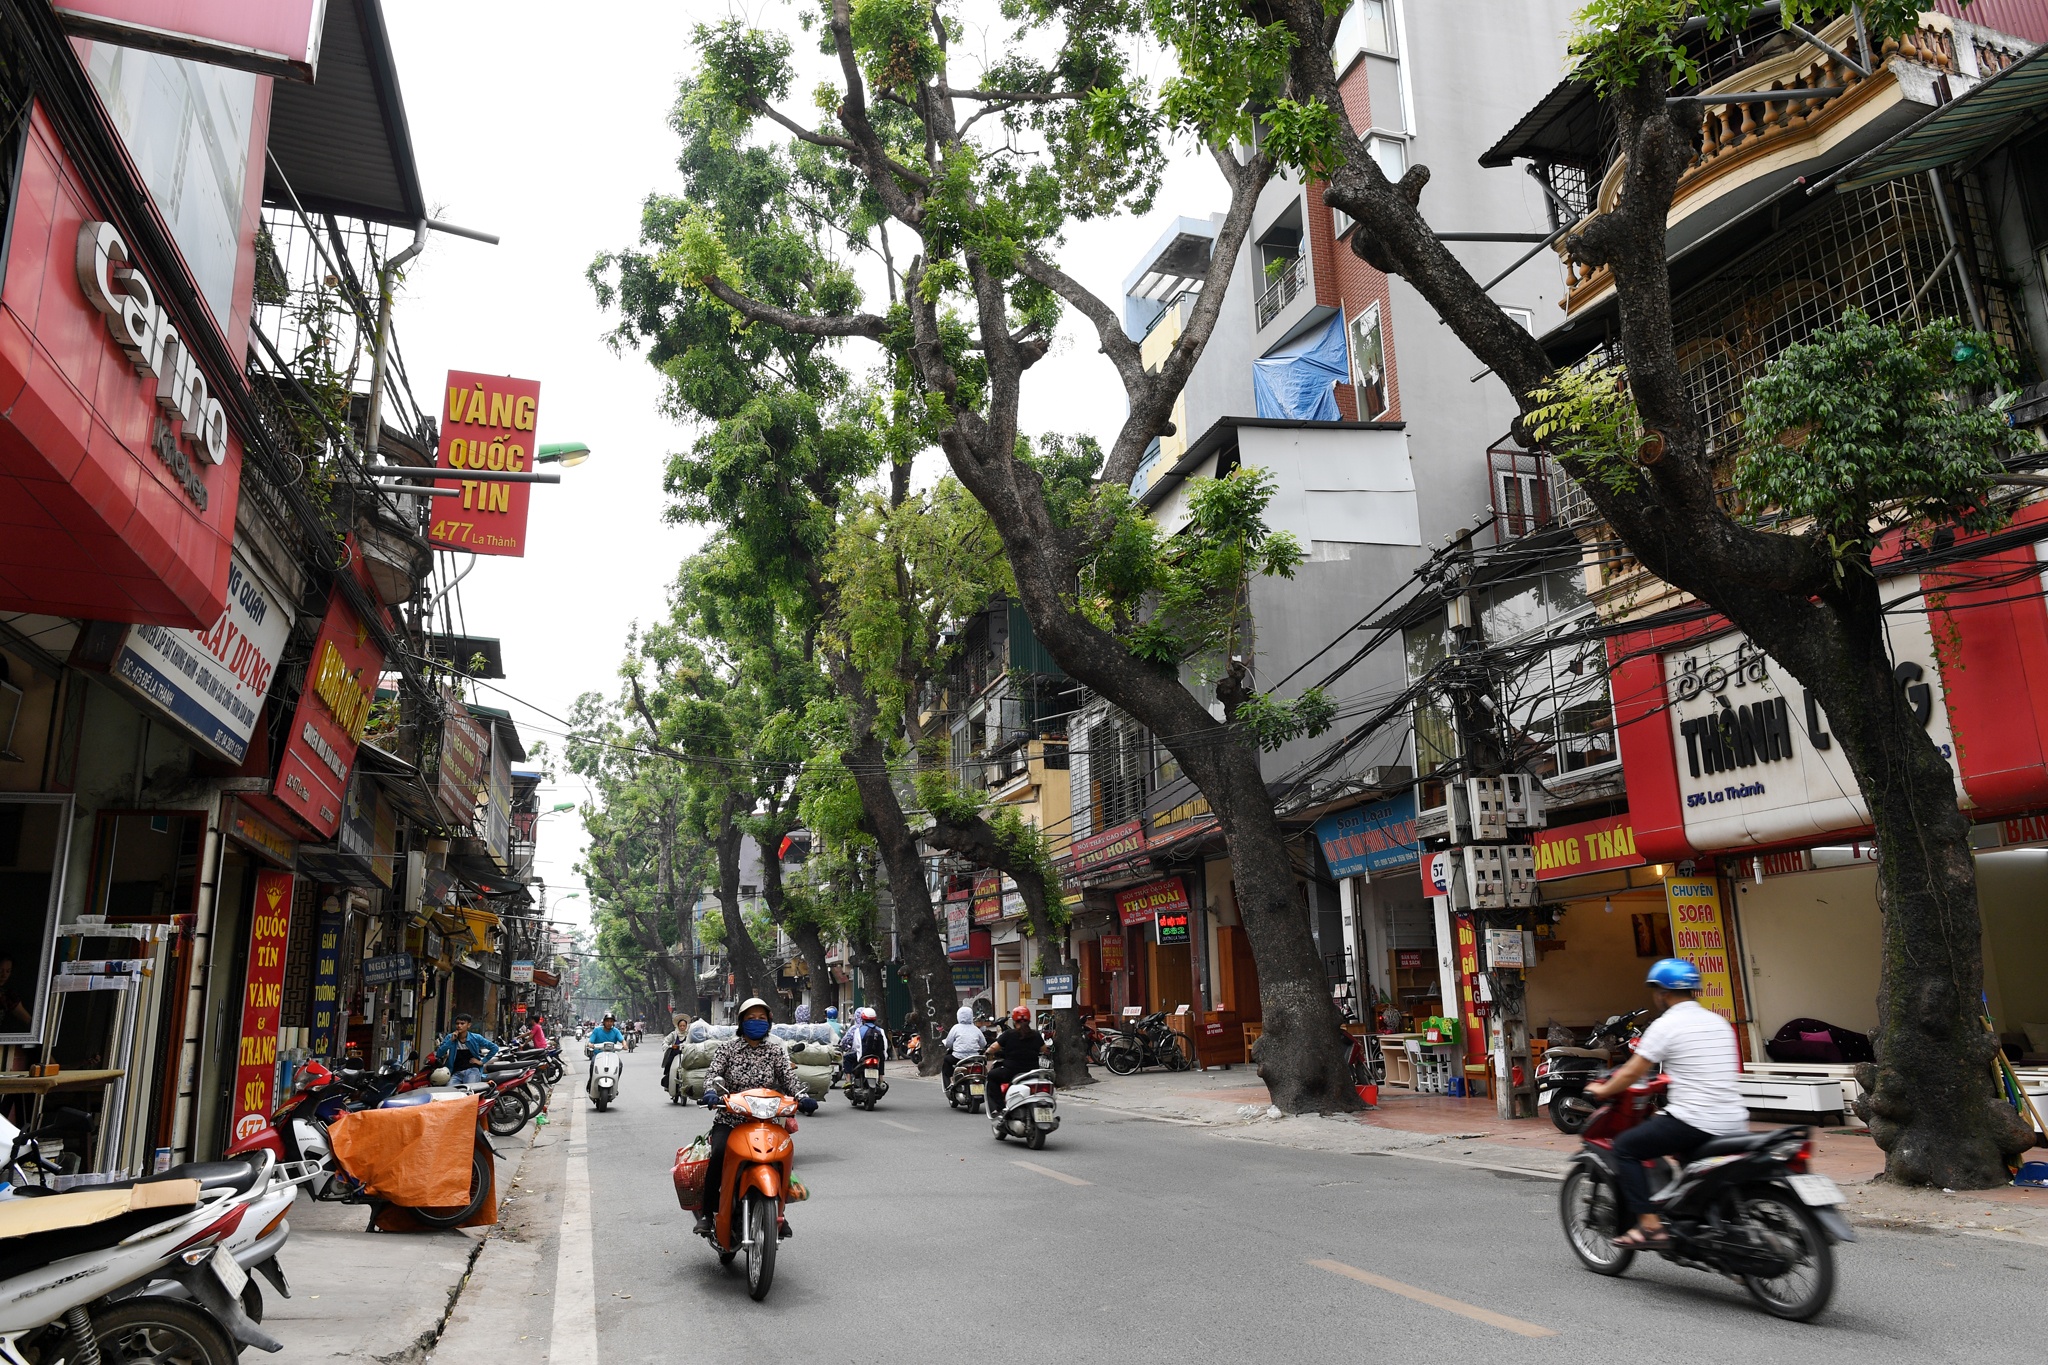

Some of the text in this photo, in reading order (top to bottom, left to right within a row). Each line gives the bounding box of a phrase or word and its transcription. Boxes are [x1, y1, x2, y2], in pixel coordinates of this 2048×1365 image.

[449, 382, 535, 432] VÀNG
[448, 434, 525, 472] QUỐC
[431, 520, 517, 548] 477 La Thành
[239, 579, 268, 627] QUÂN
[228, 633, 272, 698] DỰNG
[1680, 695, 1793, 778] THÀNH
[1687, 781, 1766, 808] 576 La Thành
[1106, 832, 1120, 843] CAO
[1107, 836, 1140, 859] HOÀI
[1584, 824, 1637, 862] THÁI
[1149, 888, 1180, 907] HOÀI
[1672, 882, 1714, 898] CHUYÊN
[255, 908, 287, 939] QUỐC
[1678, 904, 1715, 923] SOFA
[321, 927, 337, 950] GIẤY
[1458, 921, 1473, 946] ĐỒ
[1678, 926, 1722, 949] BÀN TRÀ
[257, 942, 279, 968] TÍN
[319, 957, 334, 976] DÁN
[1462, 951, 1475, 976] GỖ
[1698, 952, 1724, 973] KÍNH
[249, 976, 281, 1009] VÀNG
[314, 983, 336, 1002] TƯỜNG
[257, 1017, 266, 1030] &
[316, 1010, 330, 1029] CAO
[240, 1036, 276, 1067] TRANG
[244, 1073, 265, 1112] SỨC
